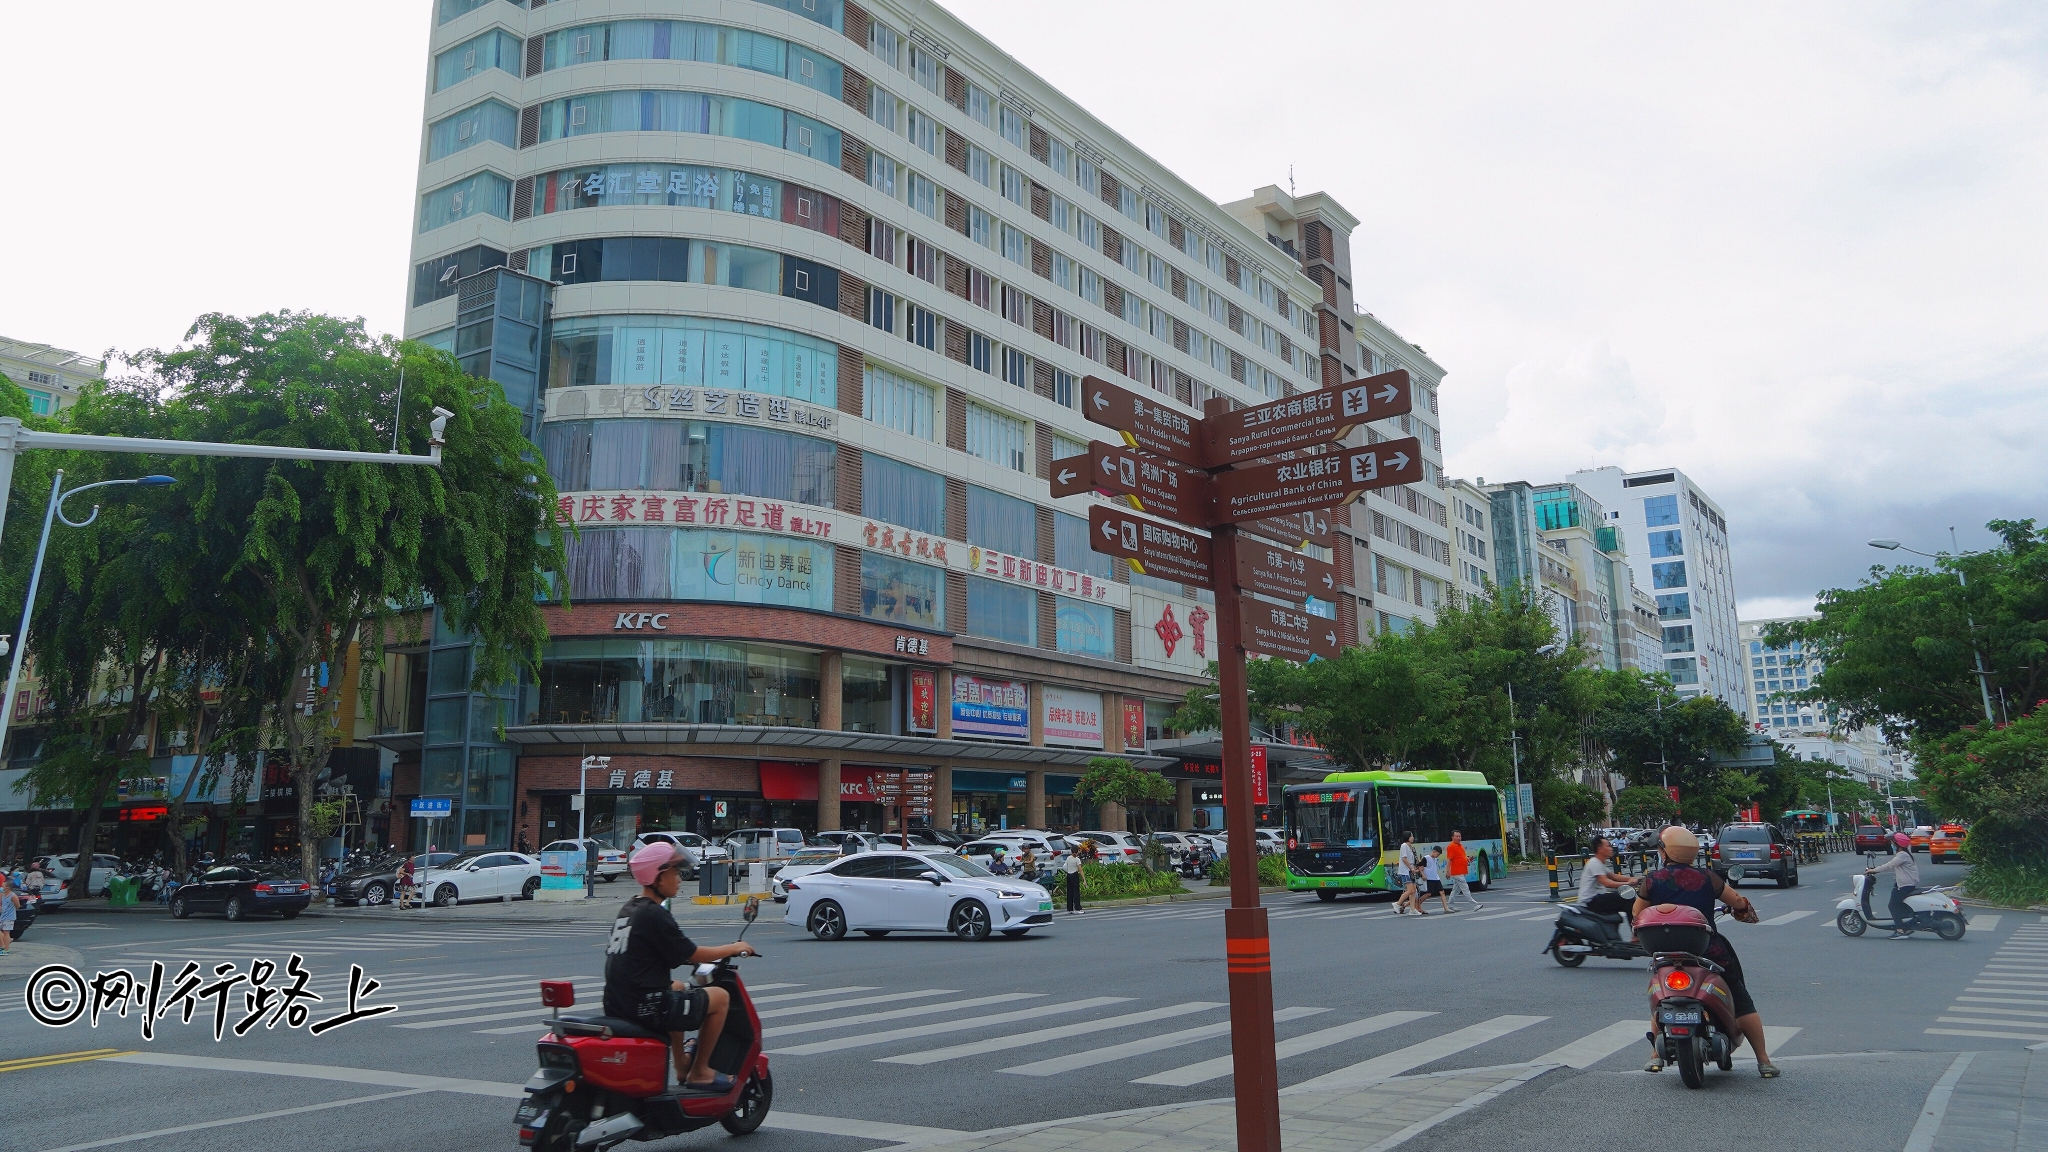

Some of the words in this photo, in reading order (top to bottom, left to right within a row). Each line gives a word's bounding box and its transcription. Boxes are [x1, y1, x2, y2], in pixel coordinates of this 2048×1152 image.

[583, 170, 721, 199] 名汇堂足浴
[669, 387, 791, 424] 丝艺造型
[794, 410, 833, 429] 请上4F
[1134, 399, 1190, 435] 第一集贸市场
[1243, 391, 1334, 428] 三亚农商银行
[1150, 428, 1172, 441] Peddler
[1171, 434, 1191, 449] Market
[1229, 435, 1250, 446] Sanya
[1251, 430, 1270, 441] Rural
[1271, 419, 1314, 436] Commercial
[1316, 413, 1335, 424] Bank
[1292, 433, 1309, 443] банк
[1140, 460, 1178, 489] 鸿洲广场
[1277, 456, 1341, 483] 农业银行
[1141, 482, 1158, 495] Visun
[1157, 488, 1177, 502] Square
[1230, 488, 1282, 506] Agricultural
[1283, 484, 1304, 495] Bank
[1306, 481, 1316, 492] of
[1317, 478, 1343, 489] China
[556, 493, 785, 531] 重庆家富富侨足道
[789, 515, 832, 538] 请上7F
[1142, 523, 1198, 554] 国际购物中心
[737, 549, 812, 575] 新迪舞蹈
[1267, 551, 1305, 574] 市第一小学
[737, 572, 774, 590] Cindy
[776, 575, 811, 592] Dance
[985, 550, 1093, 598] 三亚新迪拉丁舞
[1095, 586, 1107, 600] 3F
[1276, 573, 1292, 586] Primary
[1292, 577, 1307, 587] School
[614, 612, 670, 630] KFC
[1270, 608, 1309, 632] 市第二中学
[896, 635, 929, 655] 肯德基
[1255, 626, 1269, 638] Sanya
[1280, 631, 1295, 642] Middle
[1295, 635, 1310, 645] School
[1048, 706, 1073, 724] 品牌升级
[1075, 709, 1097, 727] 恭迎入驻
[608, 769, 674, 790] 肯德基
[841, 782, 863, 795] KFC
[265, 787, 293, 798] 二楼棋牌
[716, 803, 726, 813] K
[1289, 840, 1295, 849] 8
